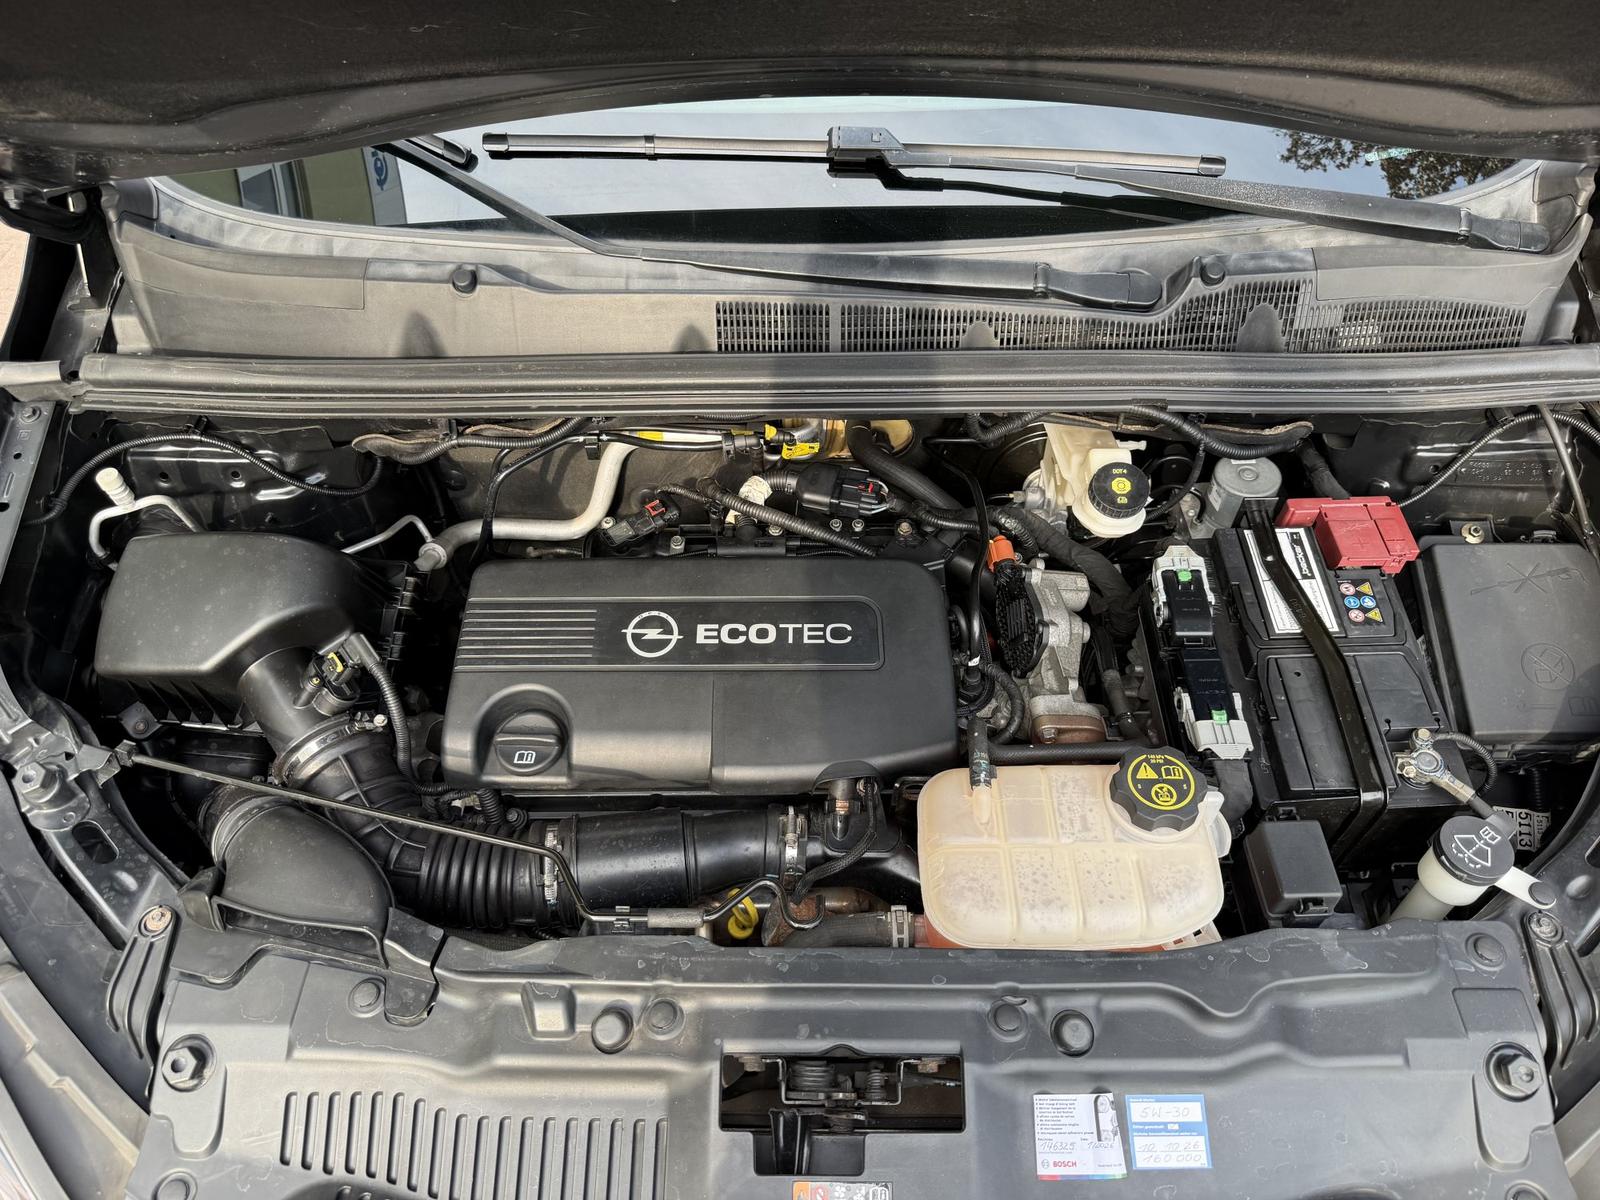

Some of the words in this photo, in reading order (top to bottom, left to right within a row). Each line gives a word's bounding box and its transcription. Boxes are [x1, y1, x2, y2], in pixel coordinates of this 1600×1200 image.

[695, 623, 853, 645] ECOTEC
[1518, 811, 1532, 847] 5113
[1053, 1160, 1077, 1168] BOSCH
